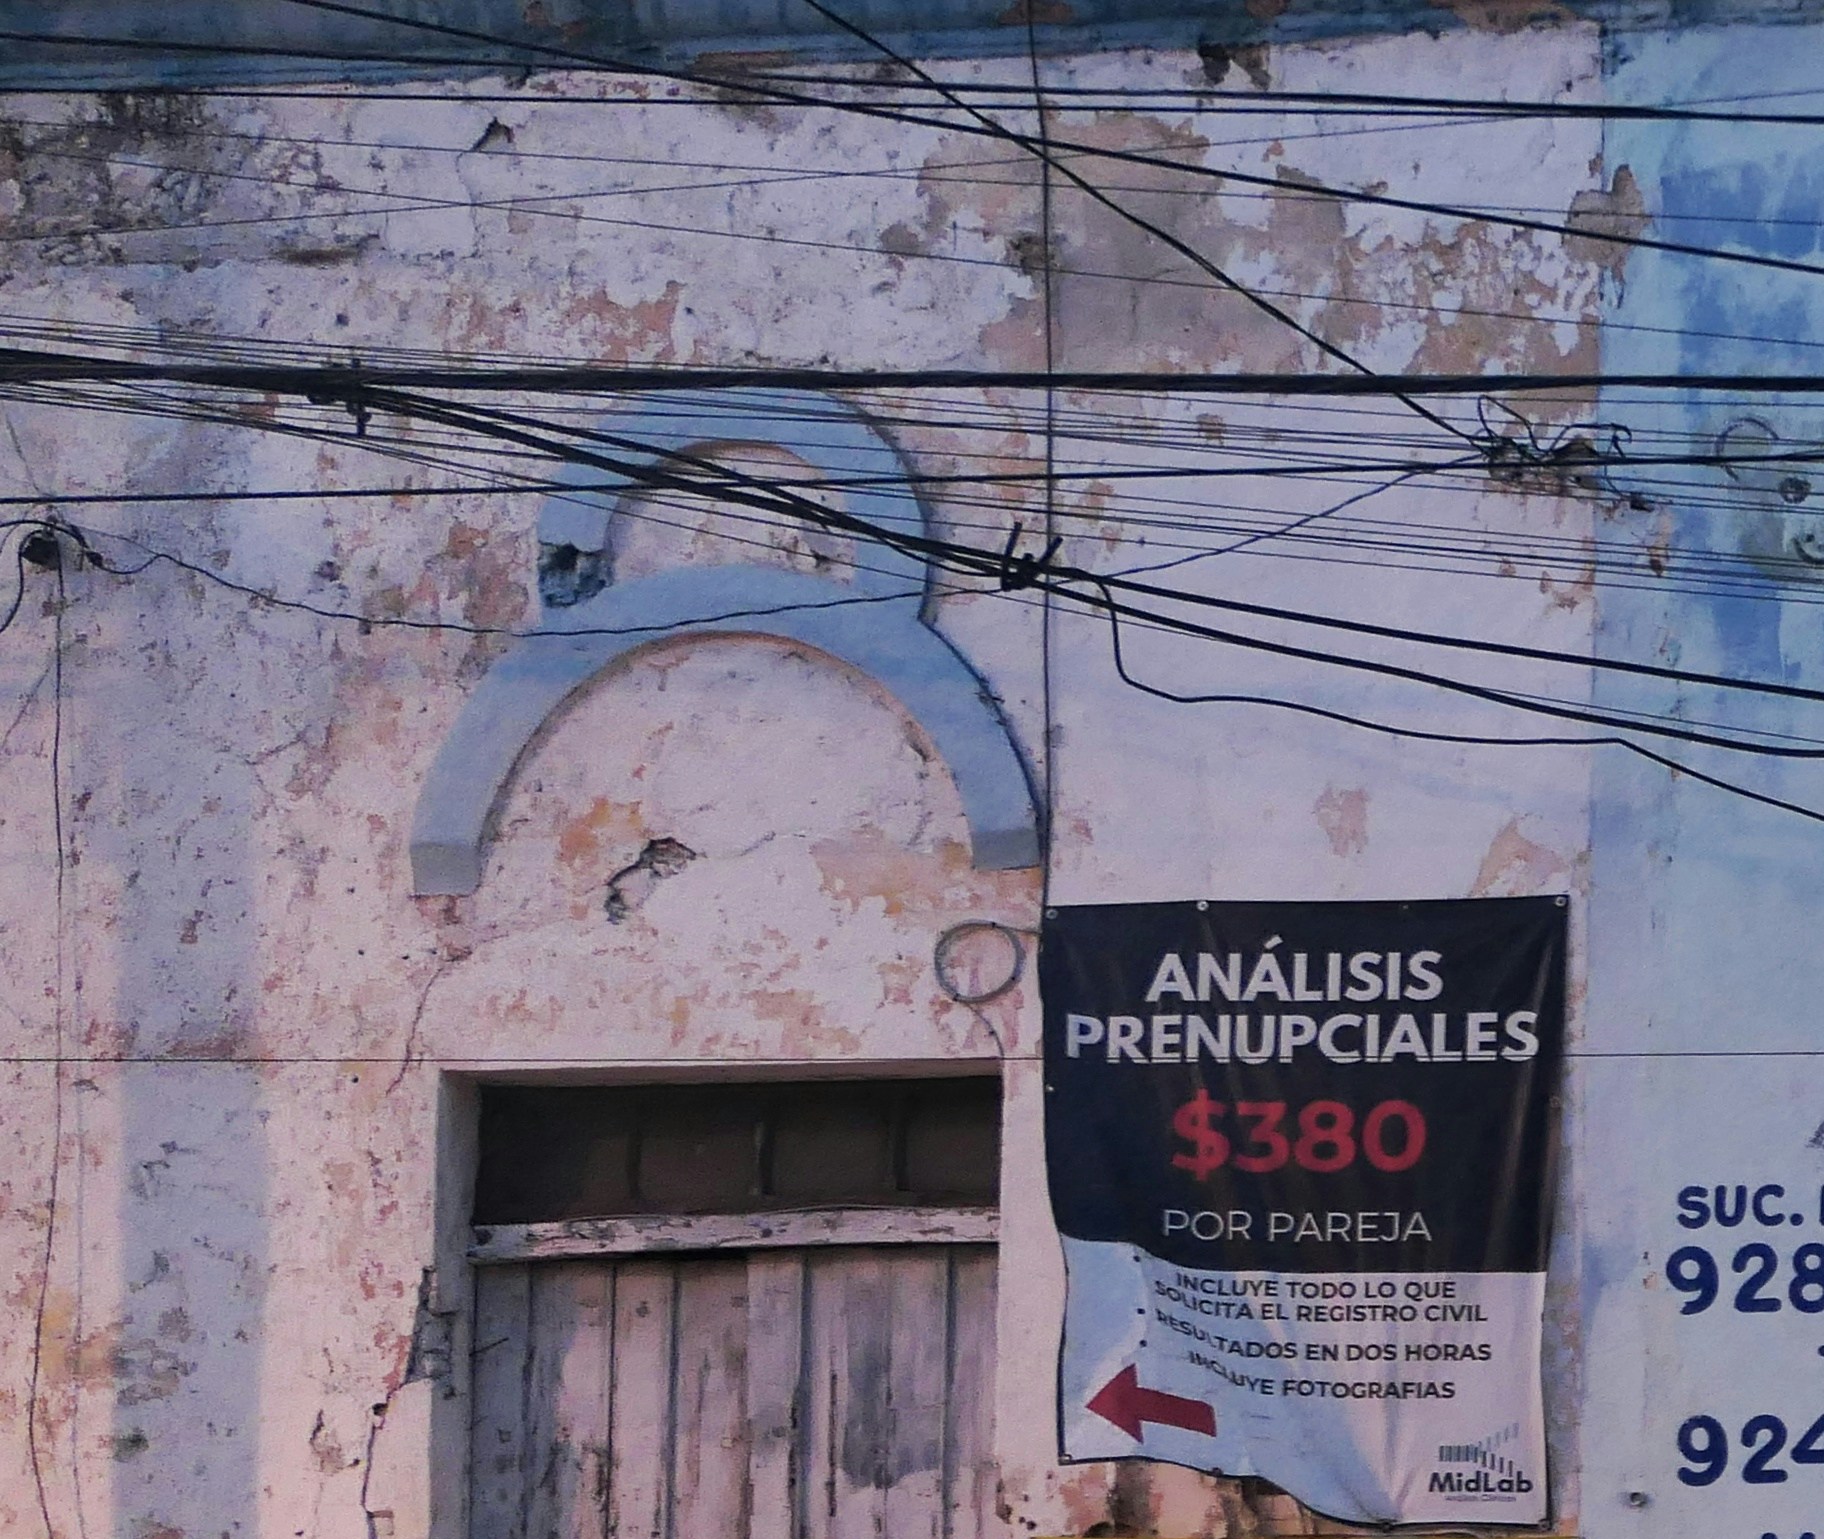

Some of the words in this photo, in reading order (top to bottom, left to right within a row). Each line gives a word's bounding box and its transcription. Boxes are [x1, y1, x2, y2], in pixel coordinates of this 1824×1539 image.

[1146, 934, 1443, 1001] ANÁLISIS
[1066, 1011, 1539, 1063] PRENUPCIALES
[1170, 1088, 1427, 1181] $380
[1162, 1210, 1252, 1241] POR
[1268, 1210, 1431, 1242] PAREJA
[1676, 1185, 1804, 1229] SUC.
[1154, 1280, 1254, 1320] SOLICITA
[1261, 1303, 1288, 1321] EL
[1297, 1304, 1418, 1322] REGISTRO
[1424, 1305, 1487, 1322] CIVIL
[1177, 1272, 1278, 1297] INCLUYE
[1286, 1281, 1356, 1299] TODO
[1364, 1282, 1396, 1299] LO
[1404, 1282, 1456, 1301] QUE
[1156, 1308, 1298, 1359] RESULTADOS
[1305, 1344, 1338, 1361] EN
[1346, 1344, 1398, 1361] DOS
[1405, 1344, 1492, 1361] HORAS
[1189, 1352, 1276, 1395] INCLUYE
[1282, 1380, 1456, 1399] FOTOGRAFIAS
[1428, 1470, 1534, 1493] MidLab
